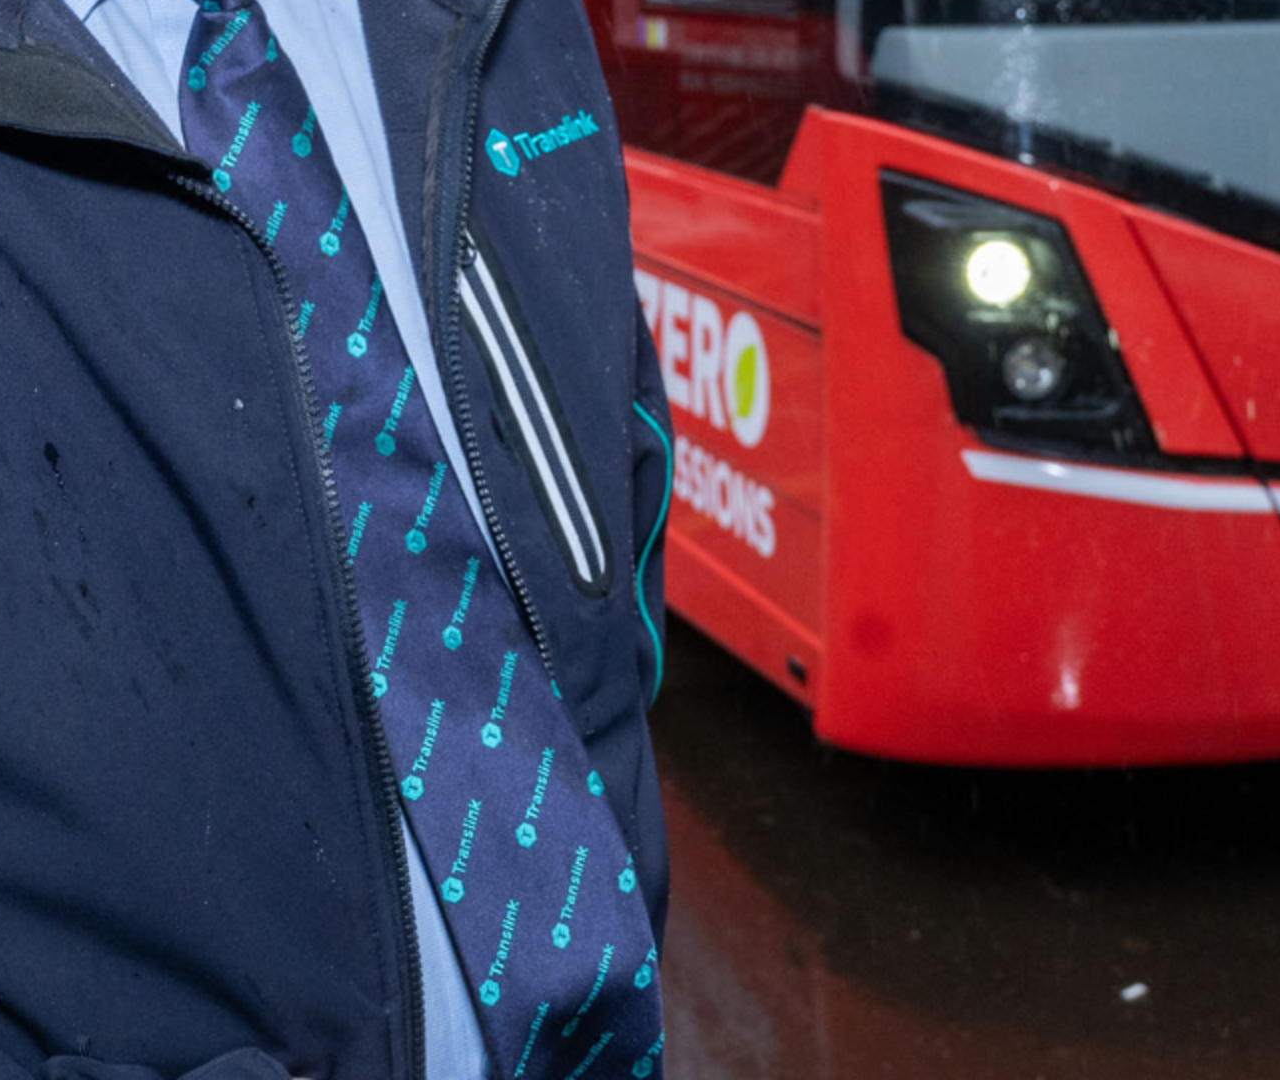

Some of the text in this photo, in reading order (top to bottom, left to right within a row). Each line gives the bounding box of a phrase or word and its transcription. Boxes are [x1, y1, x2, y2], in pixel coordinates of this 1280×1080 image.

[199, 8, 252, 67] Translink
[220, 100, 262, 168] Translink
[512, 109, 600, 161] Translink
[414, 461, 448, 529] Translink
[450, 555, 480, 624] Translink
[375, 598, 408, 670] Translink
[490, 650, 519, 721] Translink
[411, 697, 446, 772] Translink
[524, 746, 556, 820] Translink
[451, 798, 482, 874] Translink
[560, 845, 589, 920] Translink
[488, 898, 520, 977] Translink
[578, 943, 615, 1015] Translink
[514, 1000, 550, 1078] Translink
